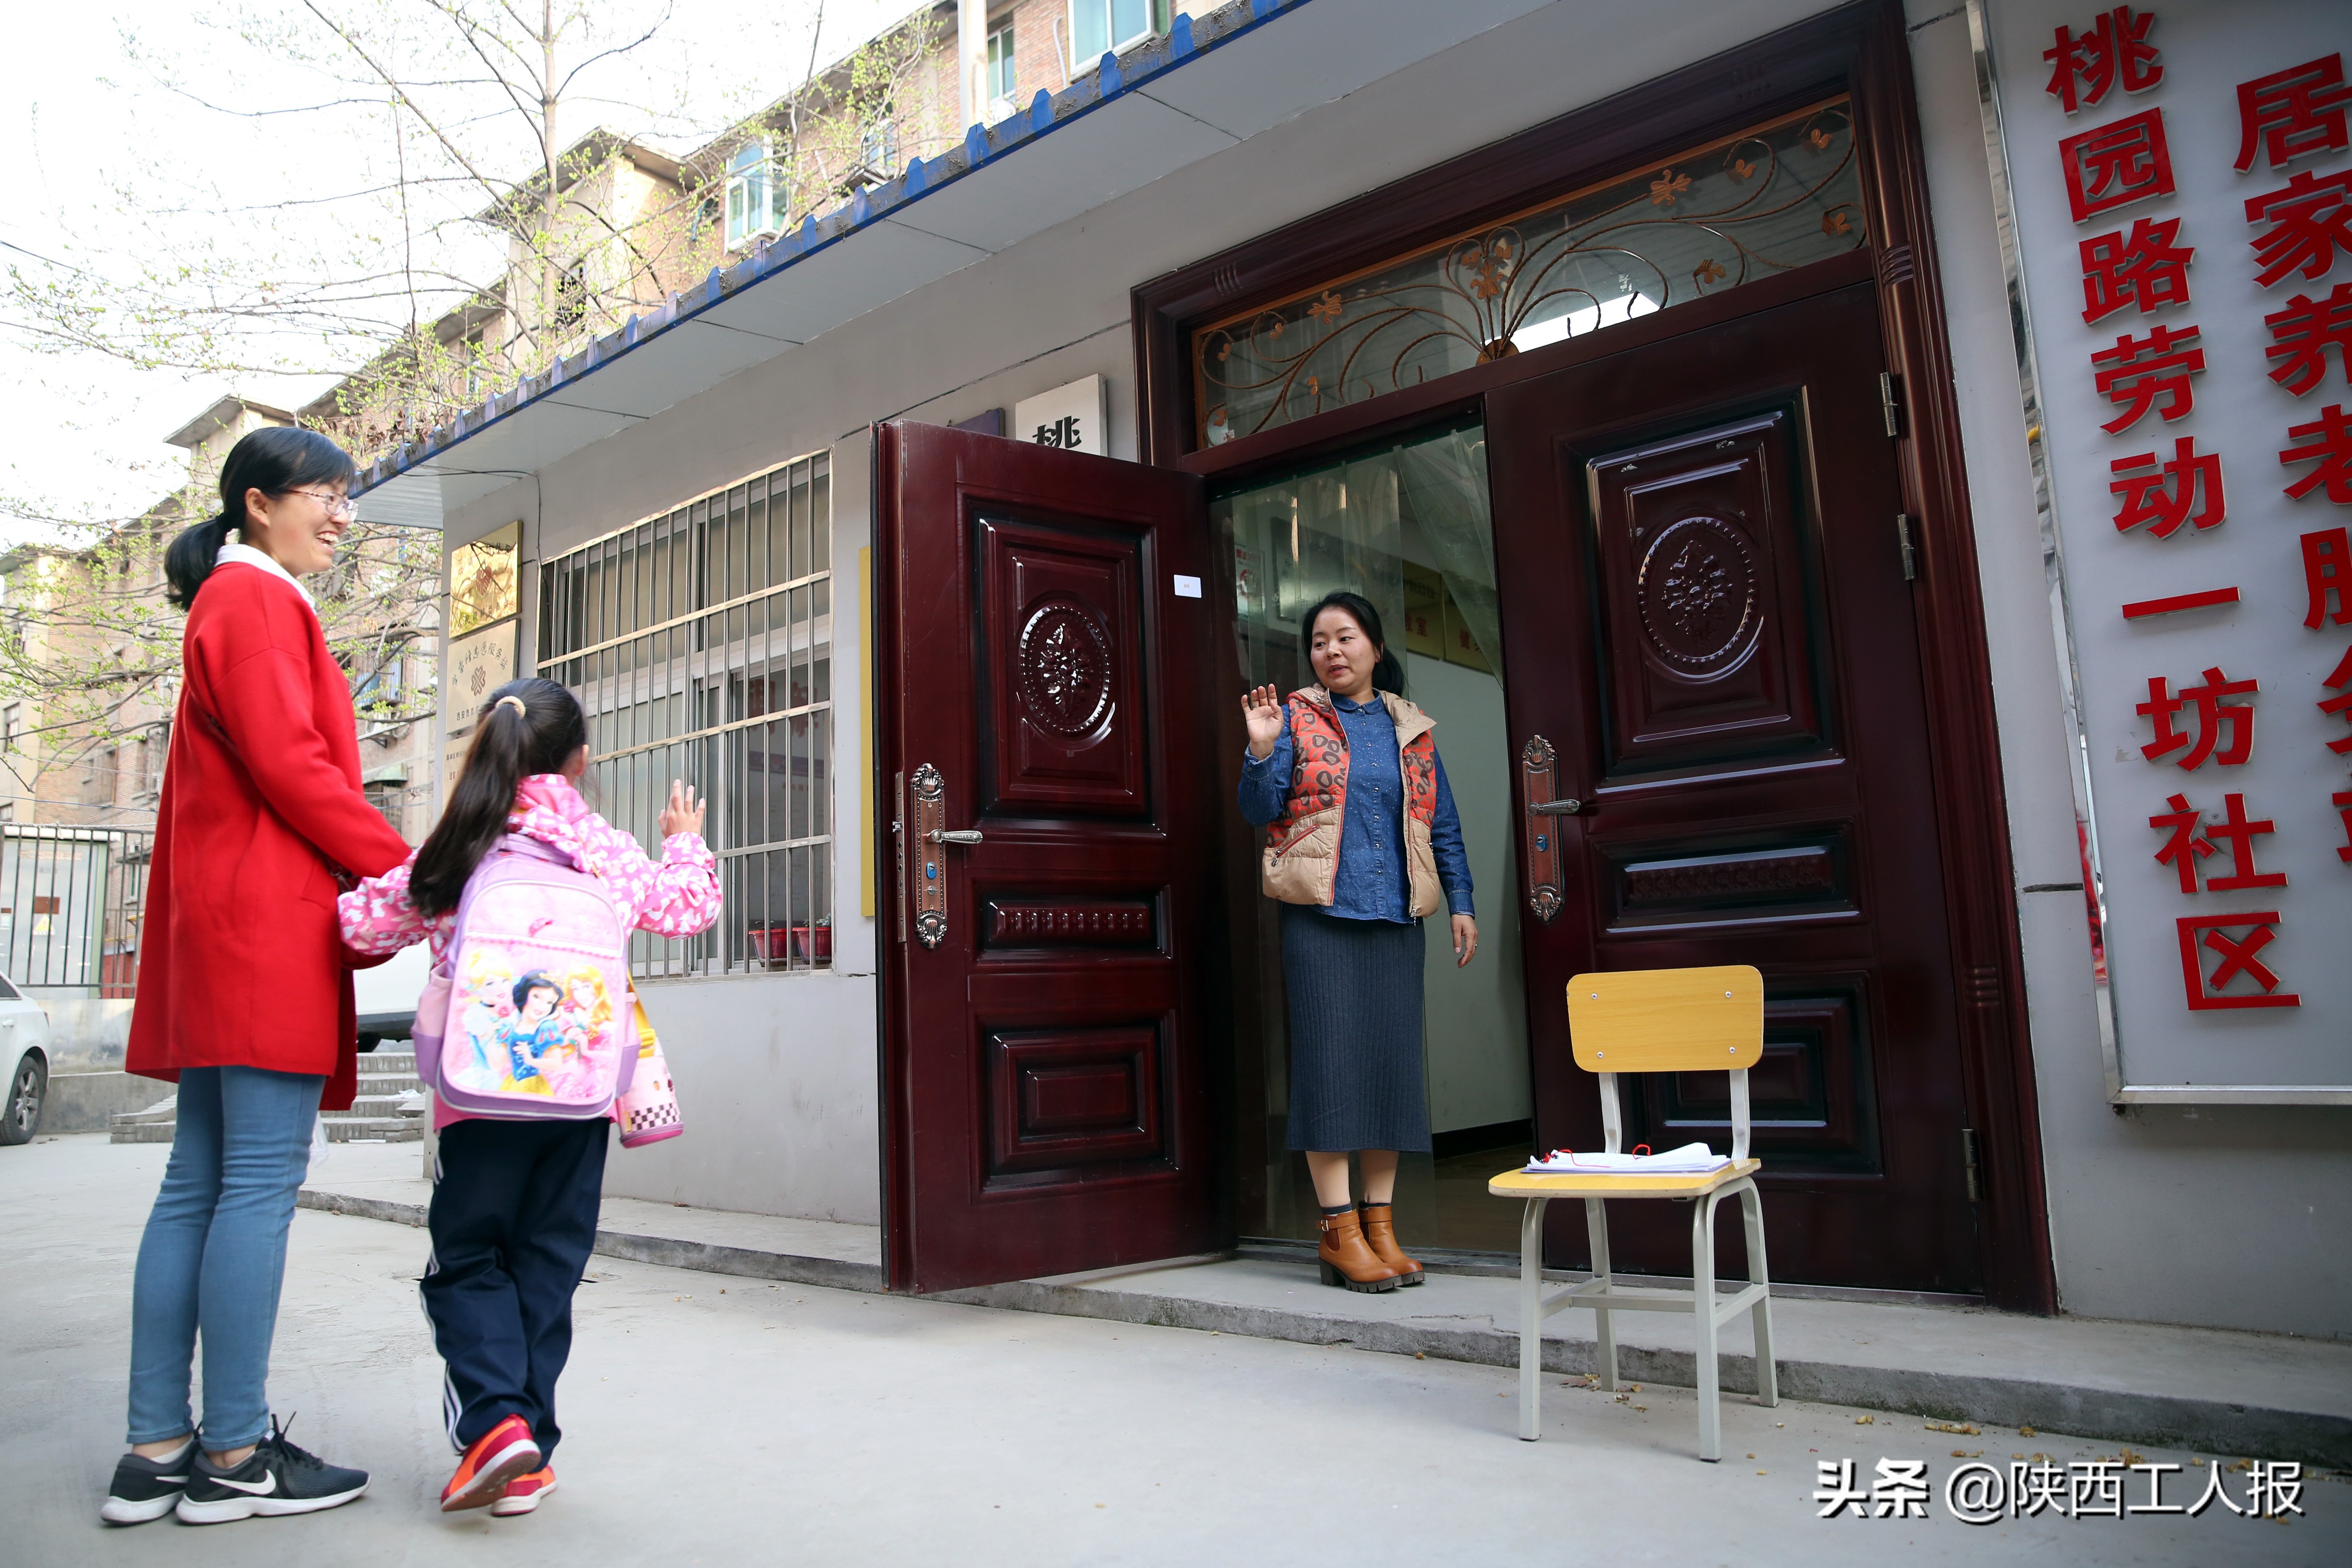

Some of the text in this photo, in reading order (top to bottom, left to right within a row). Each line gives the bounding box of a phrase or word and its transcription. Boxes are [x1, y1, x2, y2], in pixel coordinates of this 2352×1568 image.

[1031, 415, 1082, 449] 桃
[2042, 4, 2301, 1011] 桃园路劳动一坊社区
